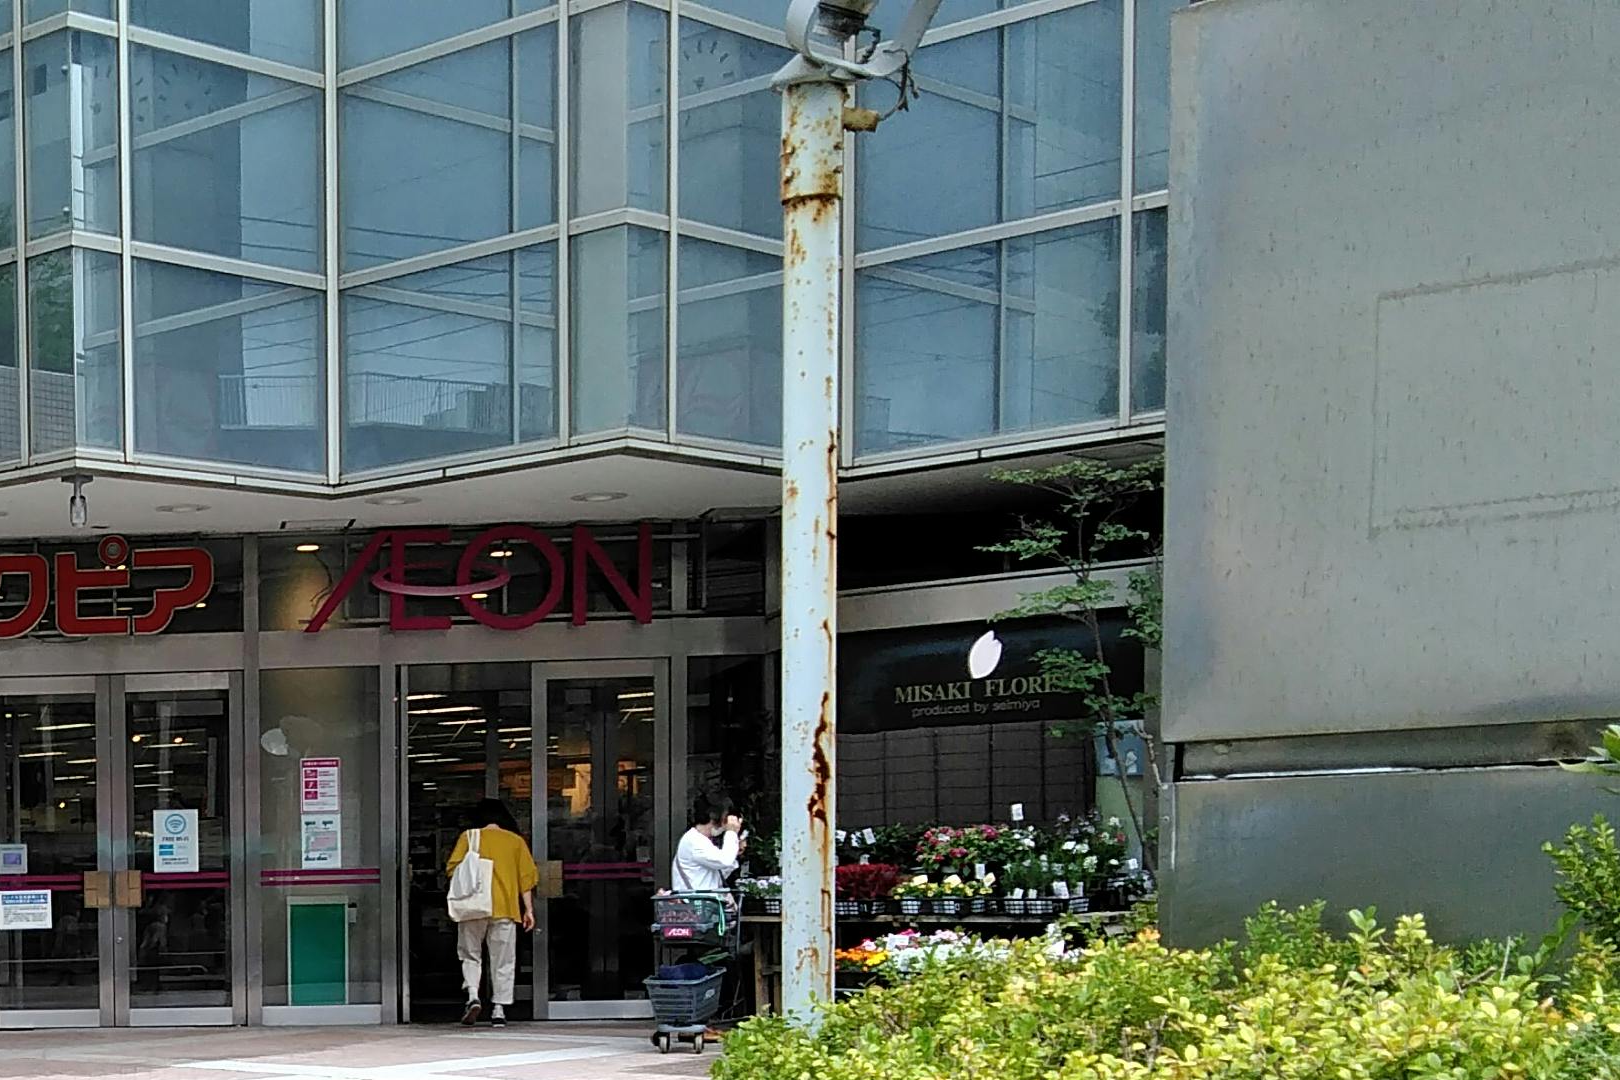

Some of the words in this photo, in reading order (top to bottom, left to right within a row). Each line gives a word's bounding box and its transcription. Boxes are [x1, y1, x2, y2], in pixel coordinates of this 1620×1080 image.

[894, 681, 973, 704] MISAKI
[912, 702, 970, 718] produced
[974, 701, 989, 714] by
